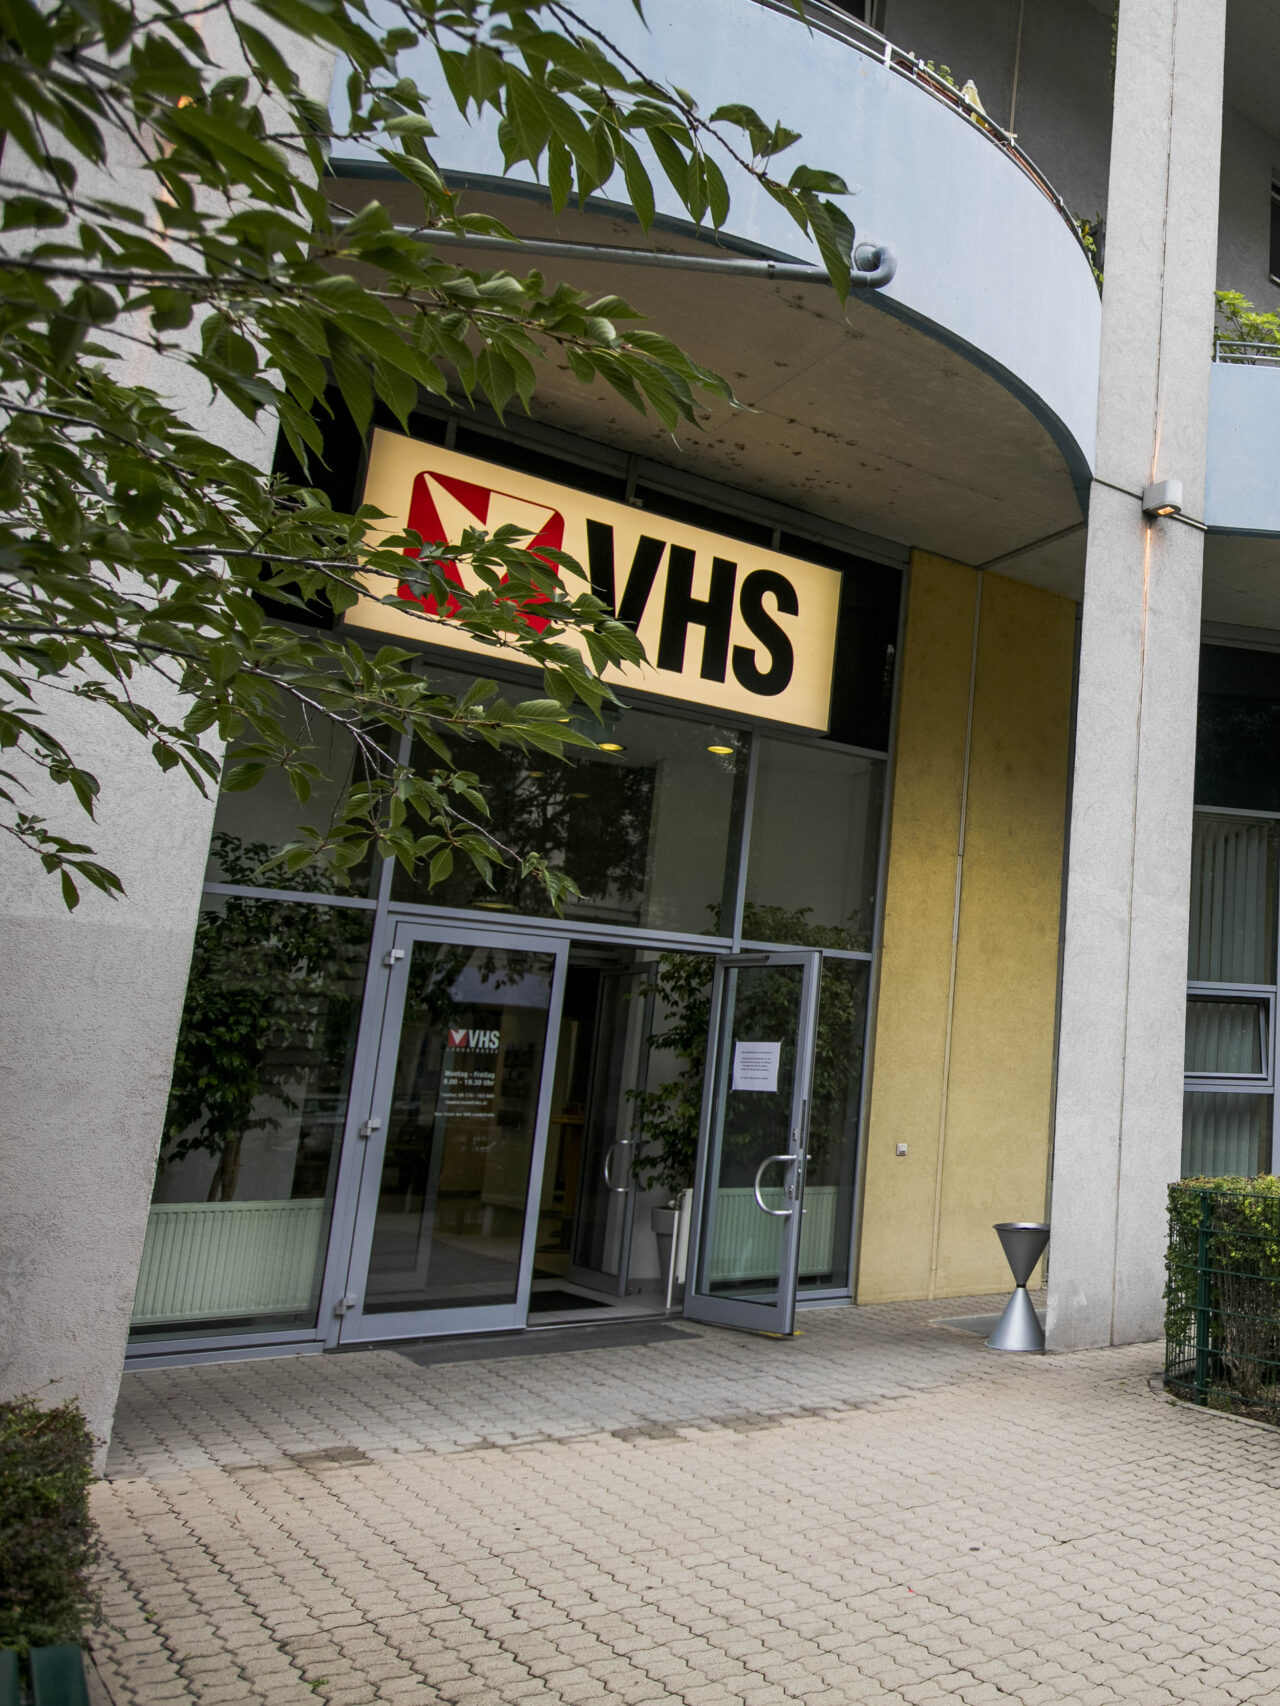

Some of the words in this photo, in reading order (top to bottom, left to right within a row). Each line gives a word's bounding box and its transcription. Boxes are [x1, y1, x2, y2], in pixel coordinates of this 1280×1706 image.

[586, 518, 799, 697] VHS
[468, 1029, 500, 1049] VHS
[445, 1070, 468, 1078] Montag
[474, 1071, 496, 1079] Freitag
